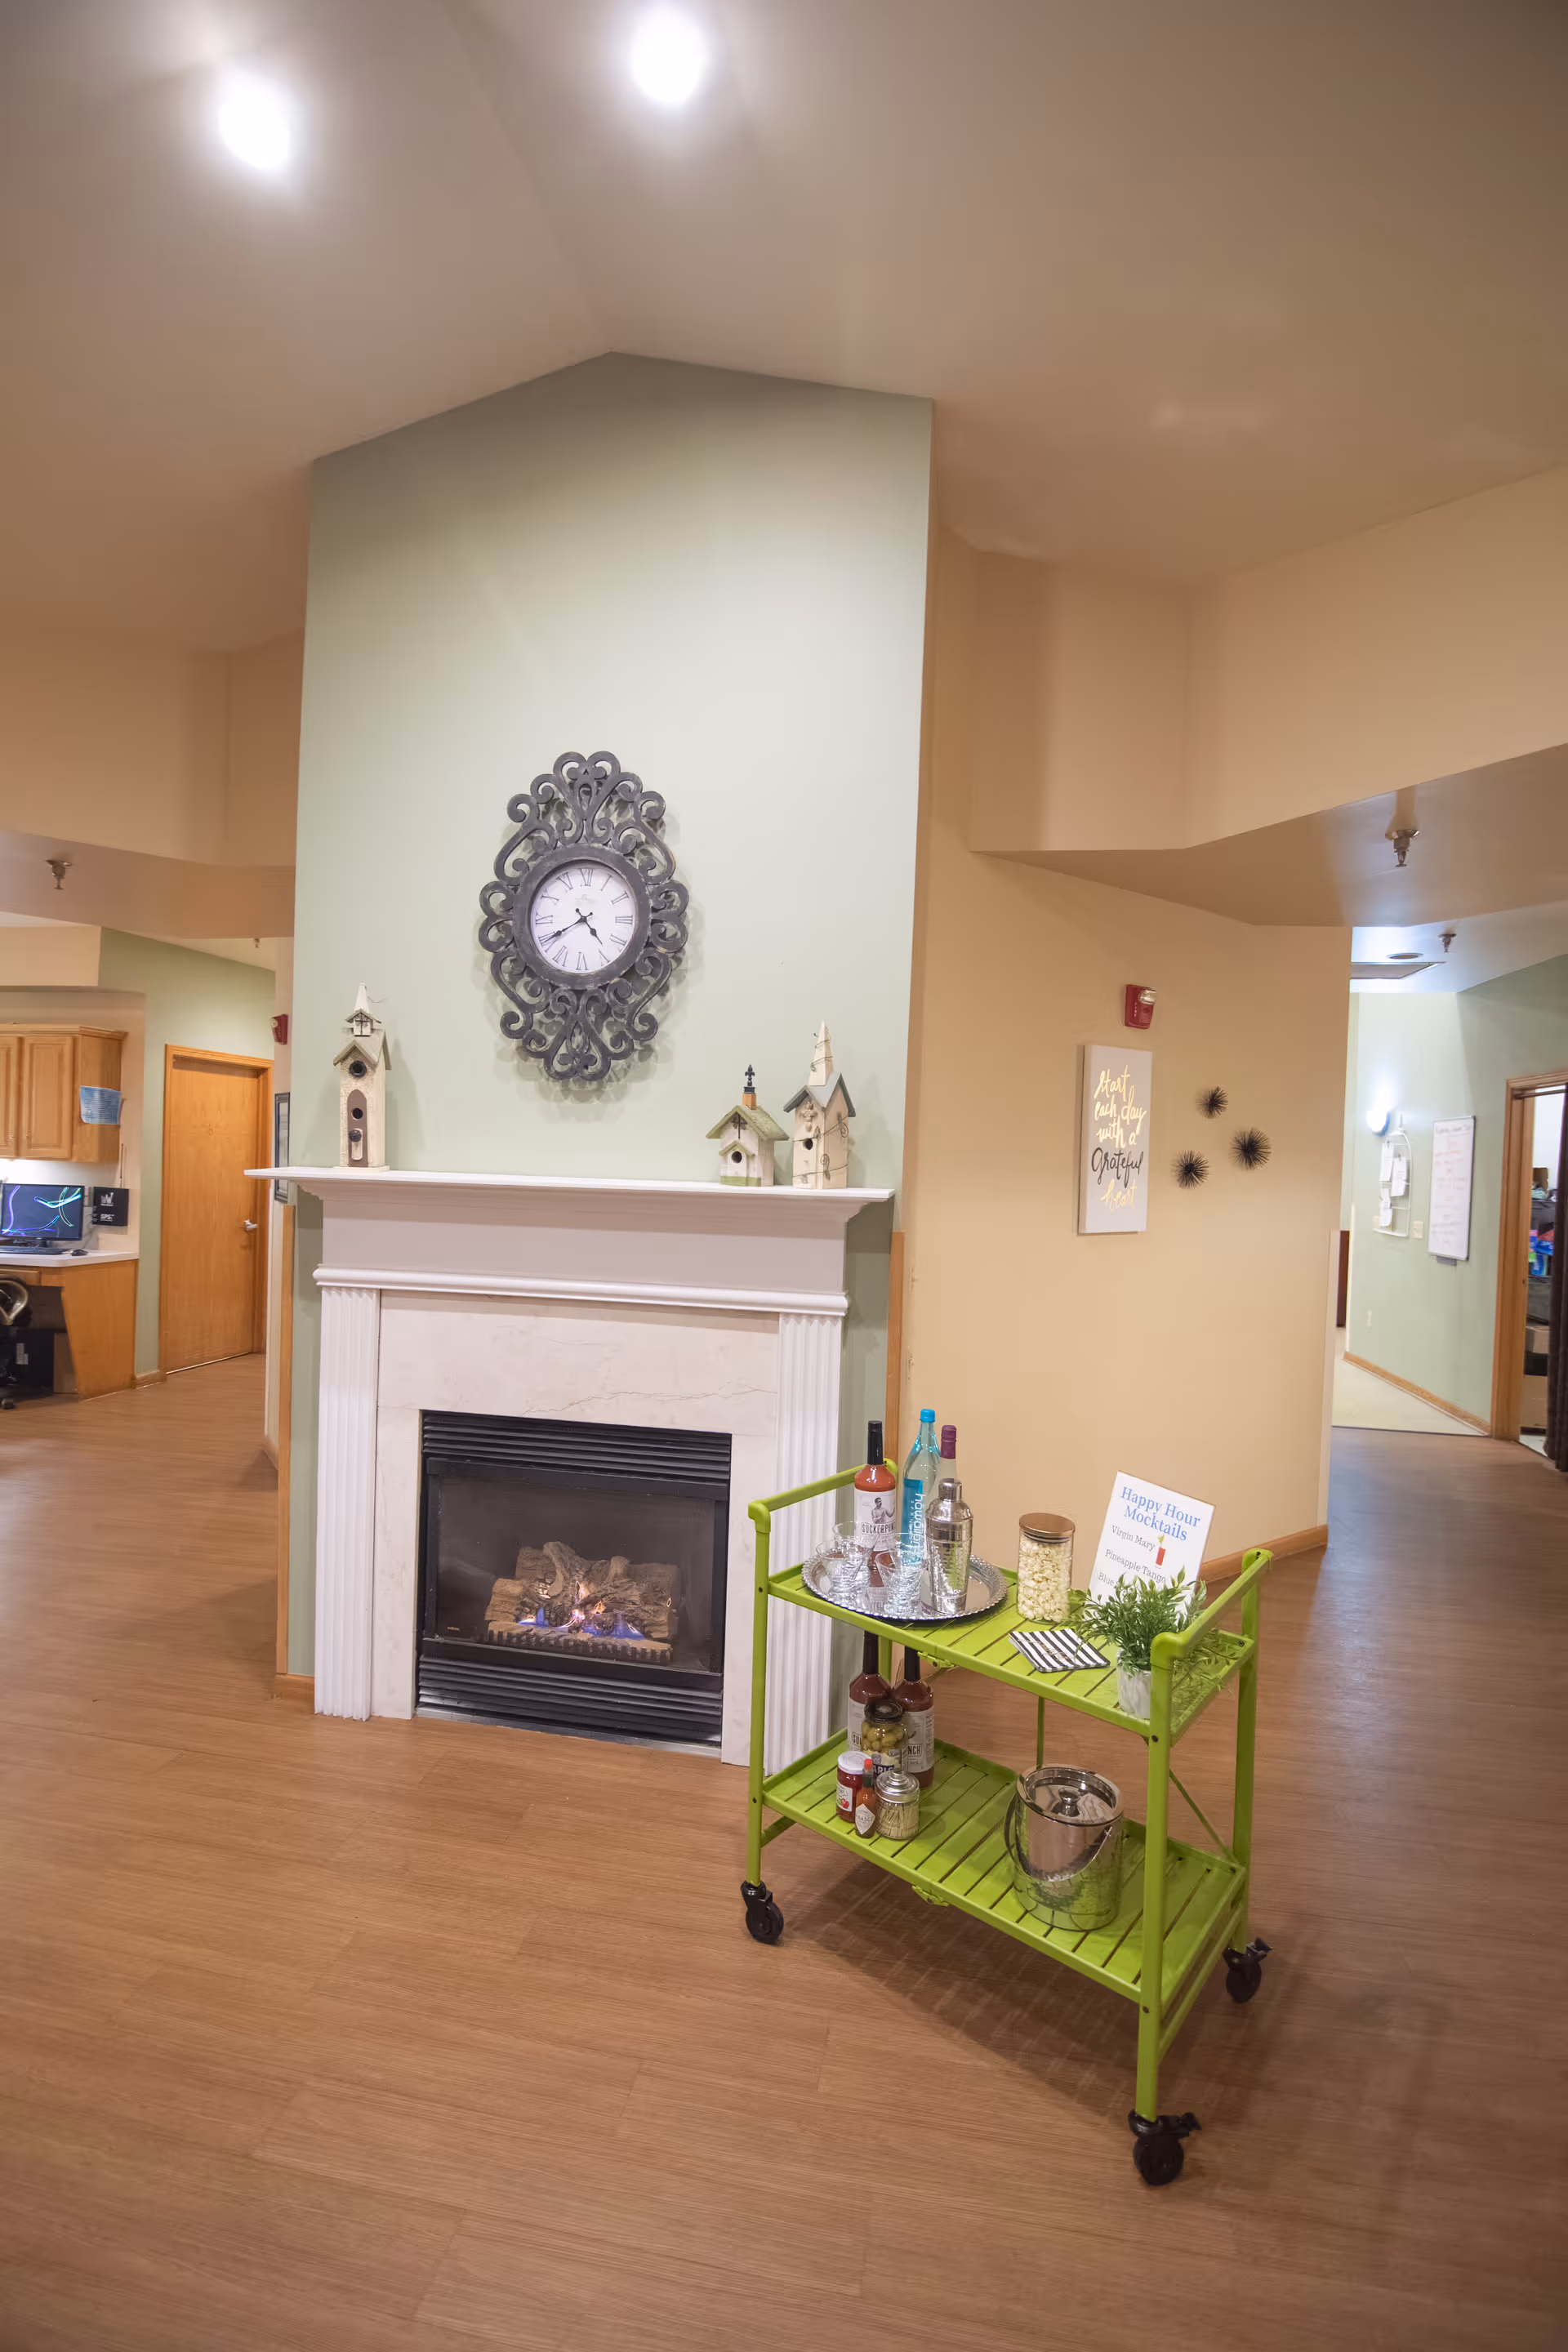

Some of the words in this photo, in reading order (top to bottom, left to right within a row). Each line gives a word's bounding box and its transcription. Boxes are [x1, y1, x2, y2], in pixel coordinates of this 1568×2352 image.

[1094, 1095, 1116, 1120] each
[1121, 1085, 1147, 1135] day
[1096, 1116, 1125, 1149] with
[1129, 1132, 1136, 1145] a
[1100, 1178, 1137, 1213] heart
[1120, 1486, 1162, 1514] Happy
[1164, 1503, 1200, 1526] Hour
[1124, 1505, 1187, 1541] Mocktails
[1111, 1525, 1134, 1542] Virgin
[1134, 1535, 1156, 1552] Mary
[1098, 1571, 1115, 1586] Blue
[1105, 1548, 1141, 1571] Pineapple
[1143, 1566, 1166, 1584] Tango
